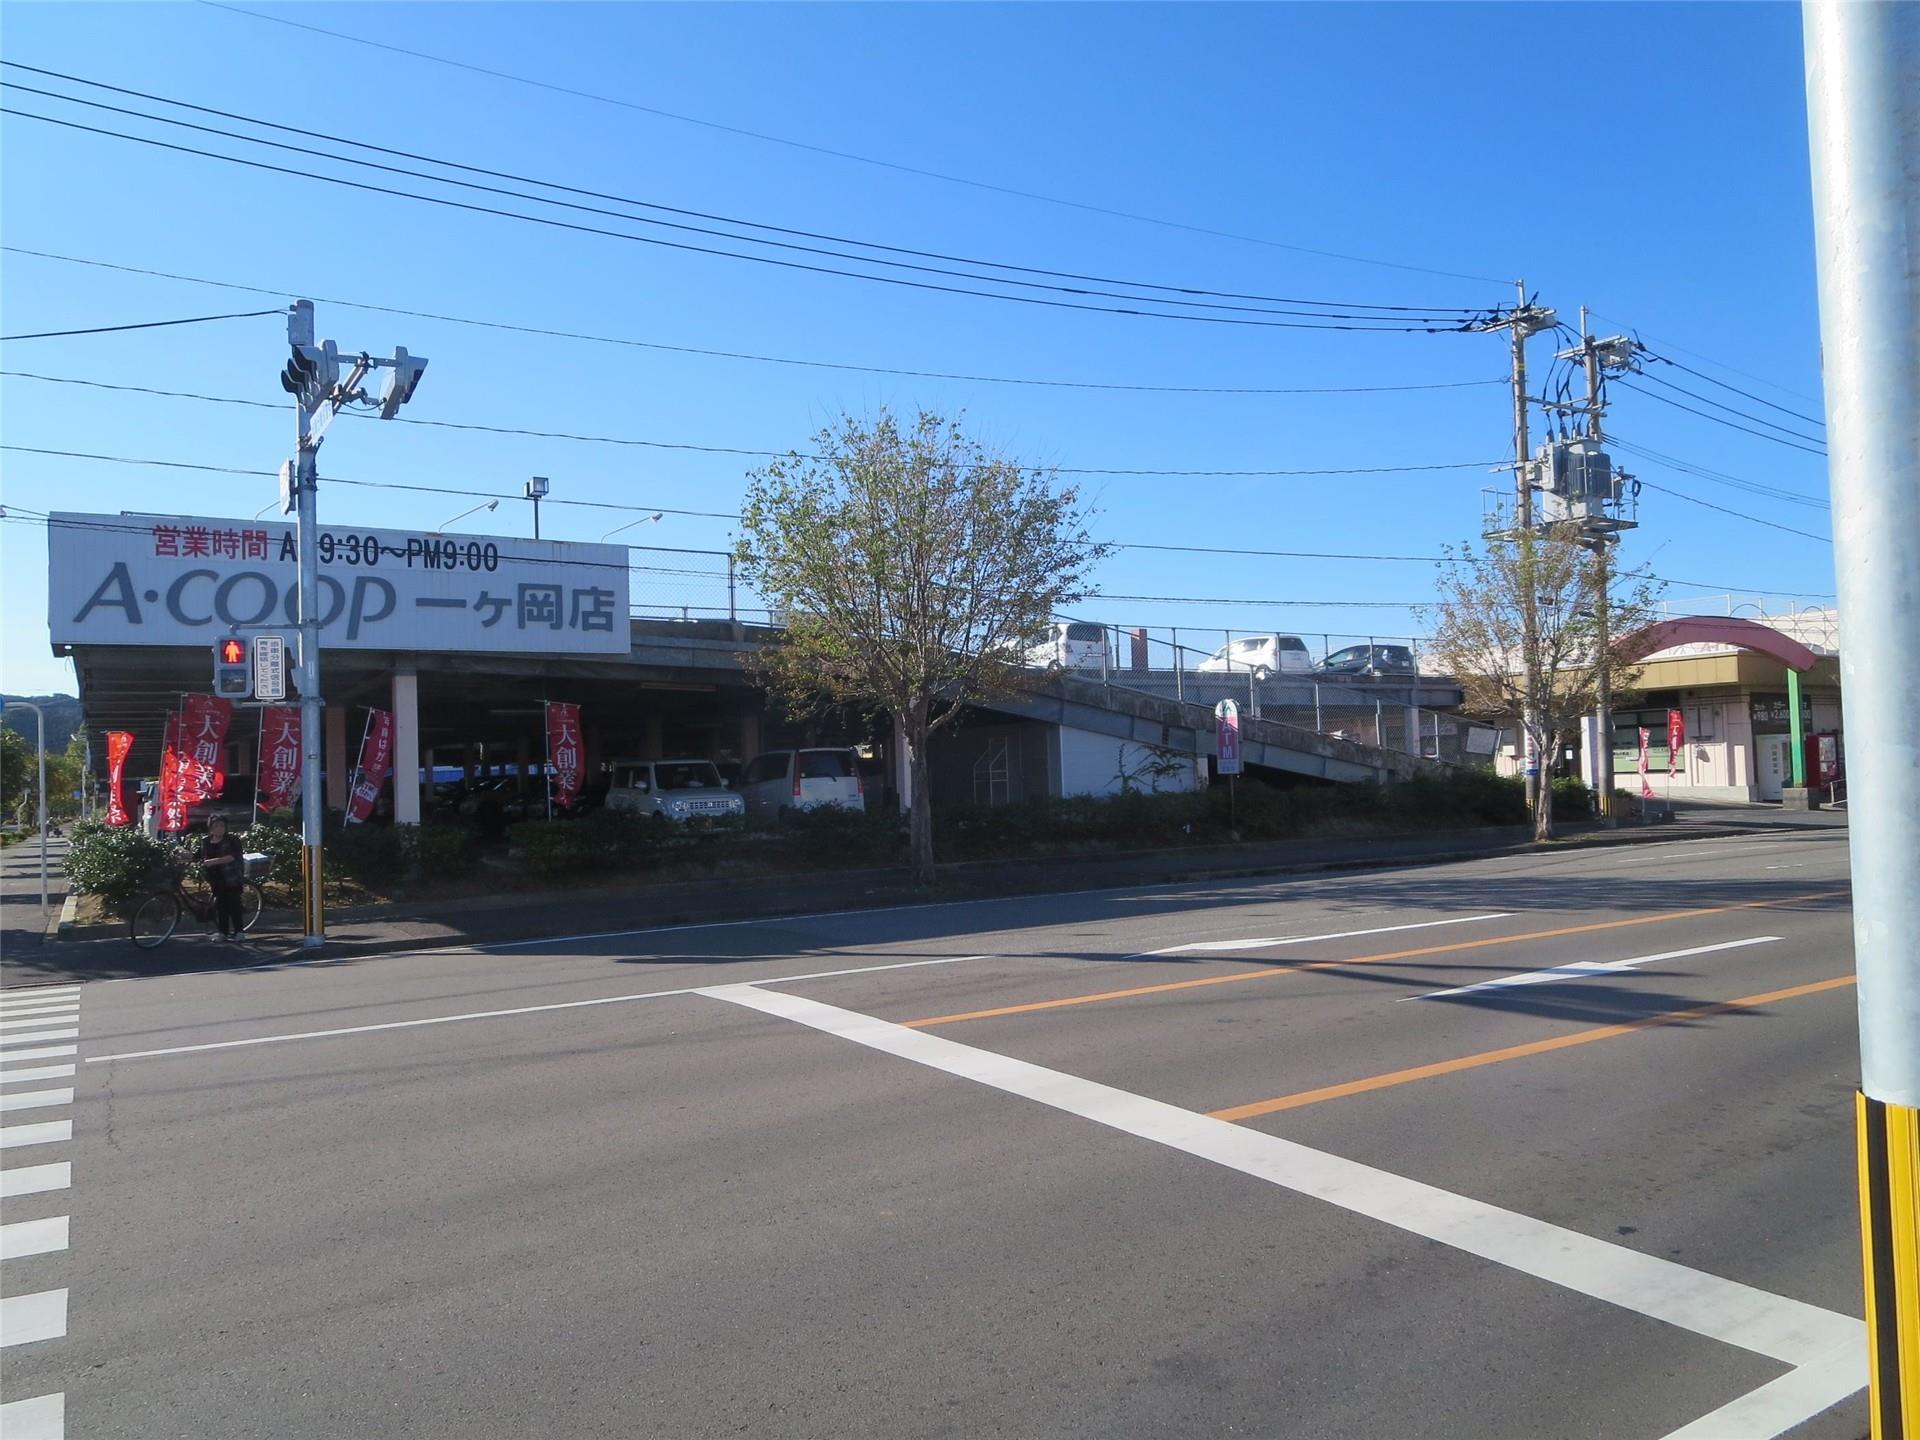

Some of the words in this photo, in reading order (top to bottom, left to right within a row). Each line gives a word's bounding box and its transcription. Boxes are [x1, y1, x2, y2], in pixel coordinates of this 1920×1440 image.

[153, 526, 268, 560] 営業時間
[280, 531, 499, 573] A9:30～PM9:00
